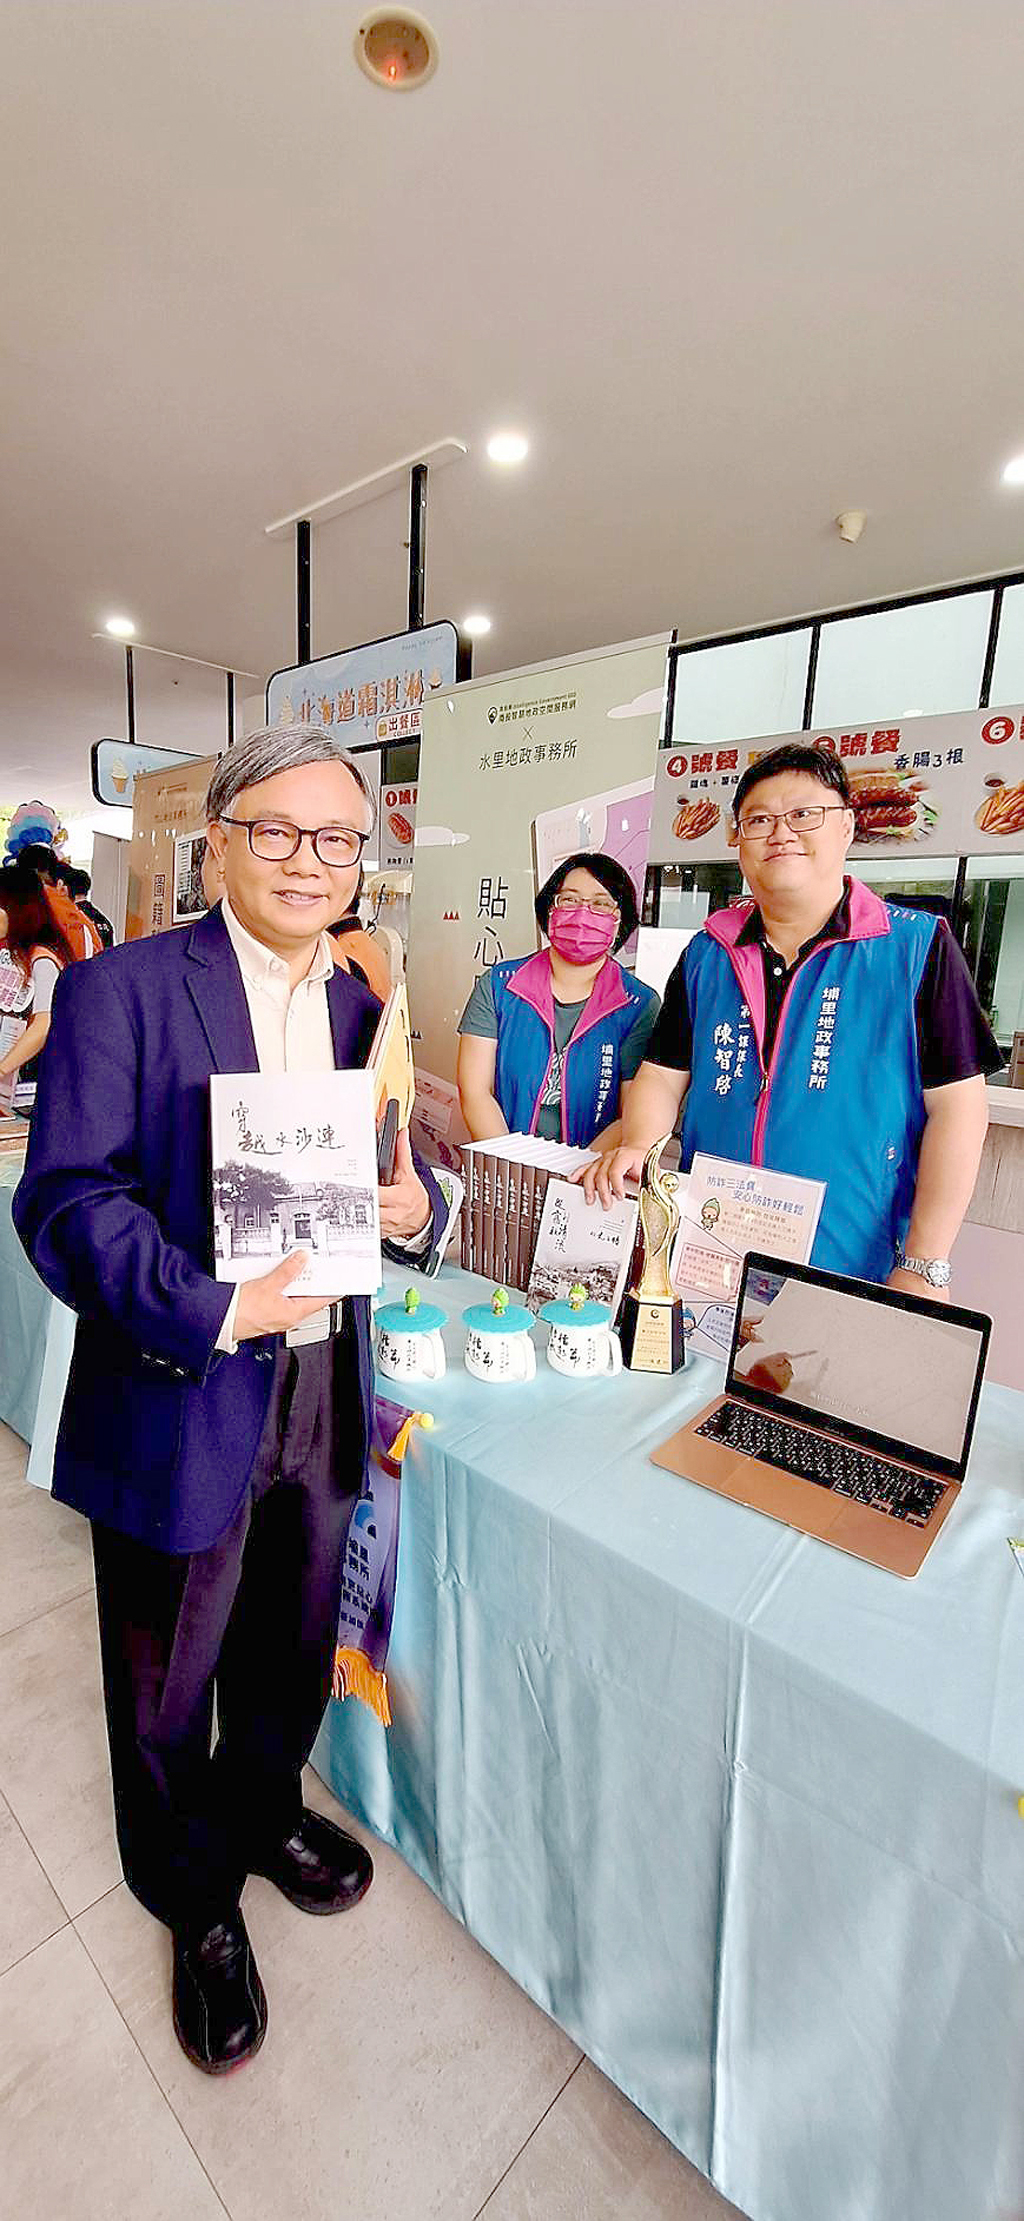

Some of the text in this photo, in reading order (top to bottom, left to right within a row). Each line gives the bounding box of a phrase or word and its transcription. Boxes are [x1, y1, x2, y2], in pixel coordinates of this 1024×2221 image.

[479, 739, 577, 771] 水里地政事務所
[981, 715, 1024, 745] 6
[473, 876, 509, 988] 貼心
[809, 986, 840, 1090] 埔里地政事務所
